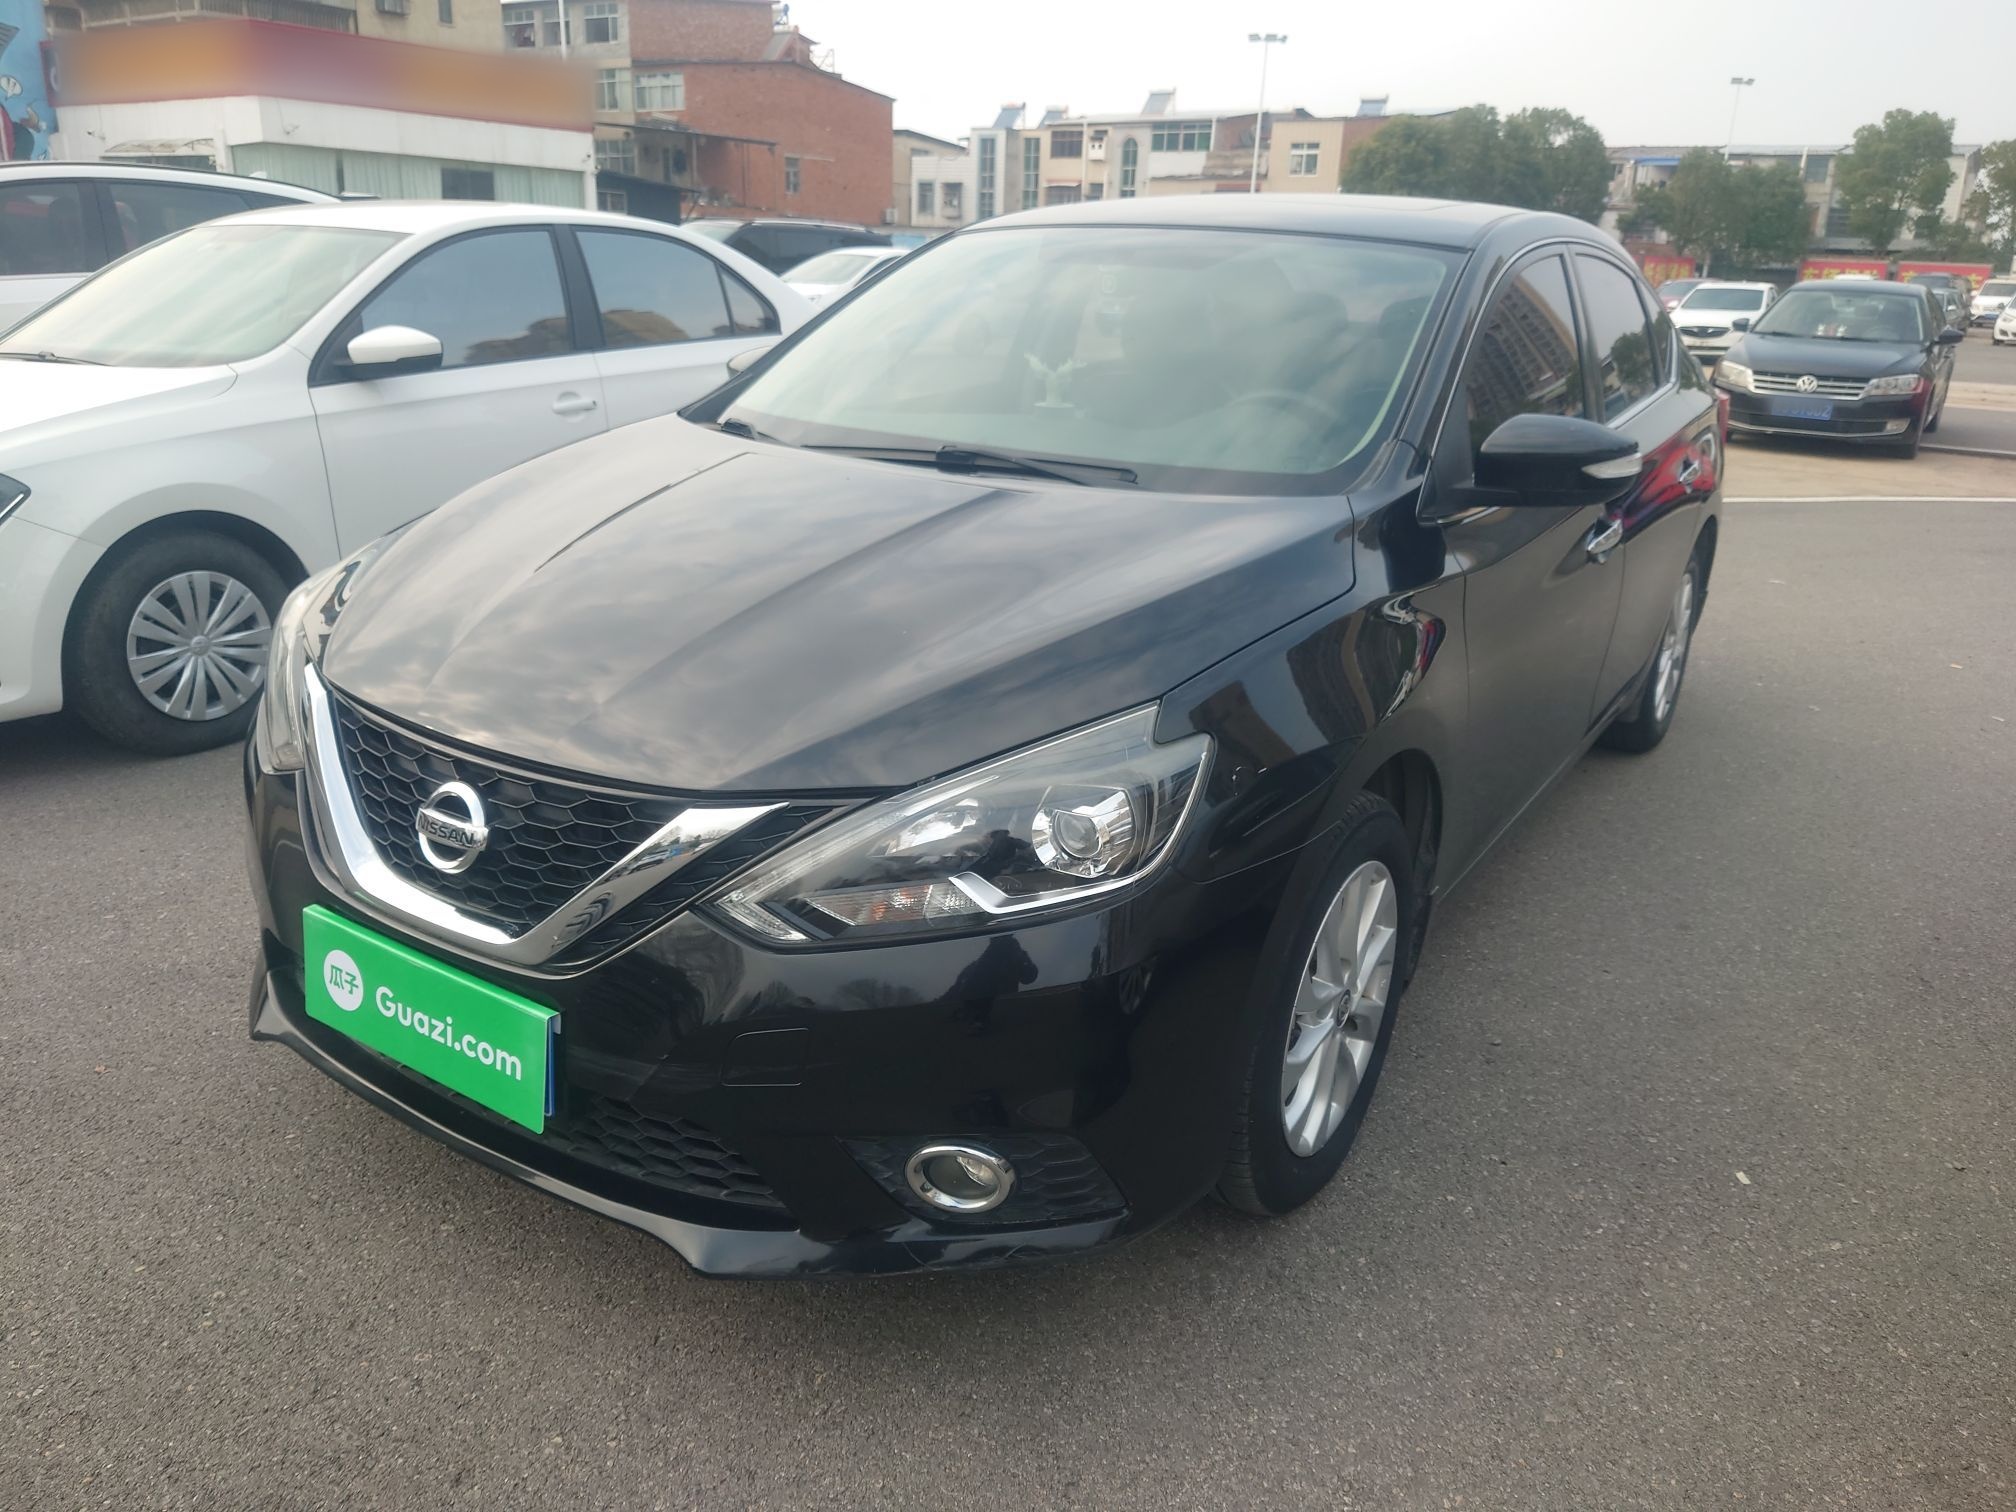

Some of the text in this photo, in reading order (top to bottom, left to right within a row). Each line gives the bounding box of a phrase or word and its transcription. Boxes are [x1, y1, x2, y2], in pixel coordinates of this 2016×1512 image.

[418, 813, 474, 846] NISSAN
[329, 964, 359, 995] 瓜子
[375, 986, 522, 1081] Guazi.com
